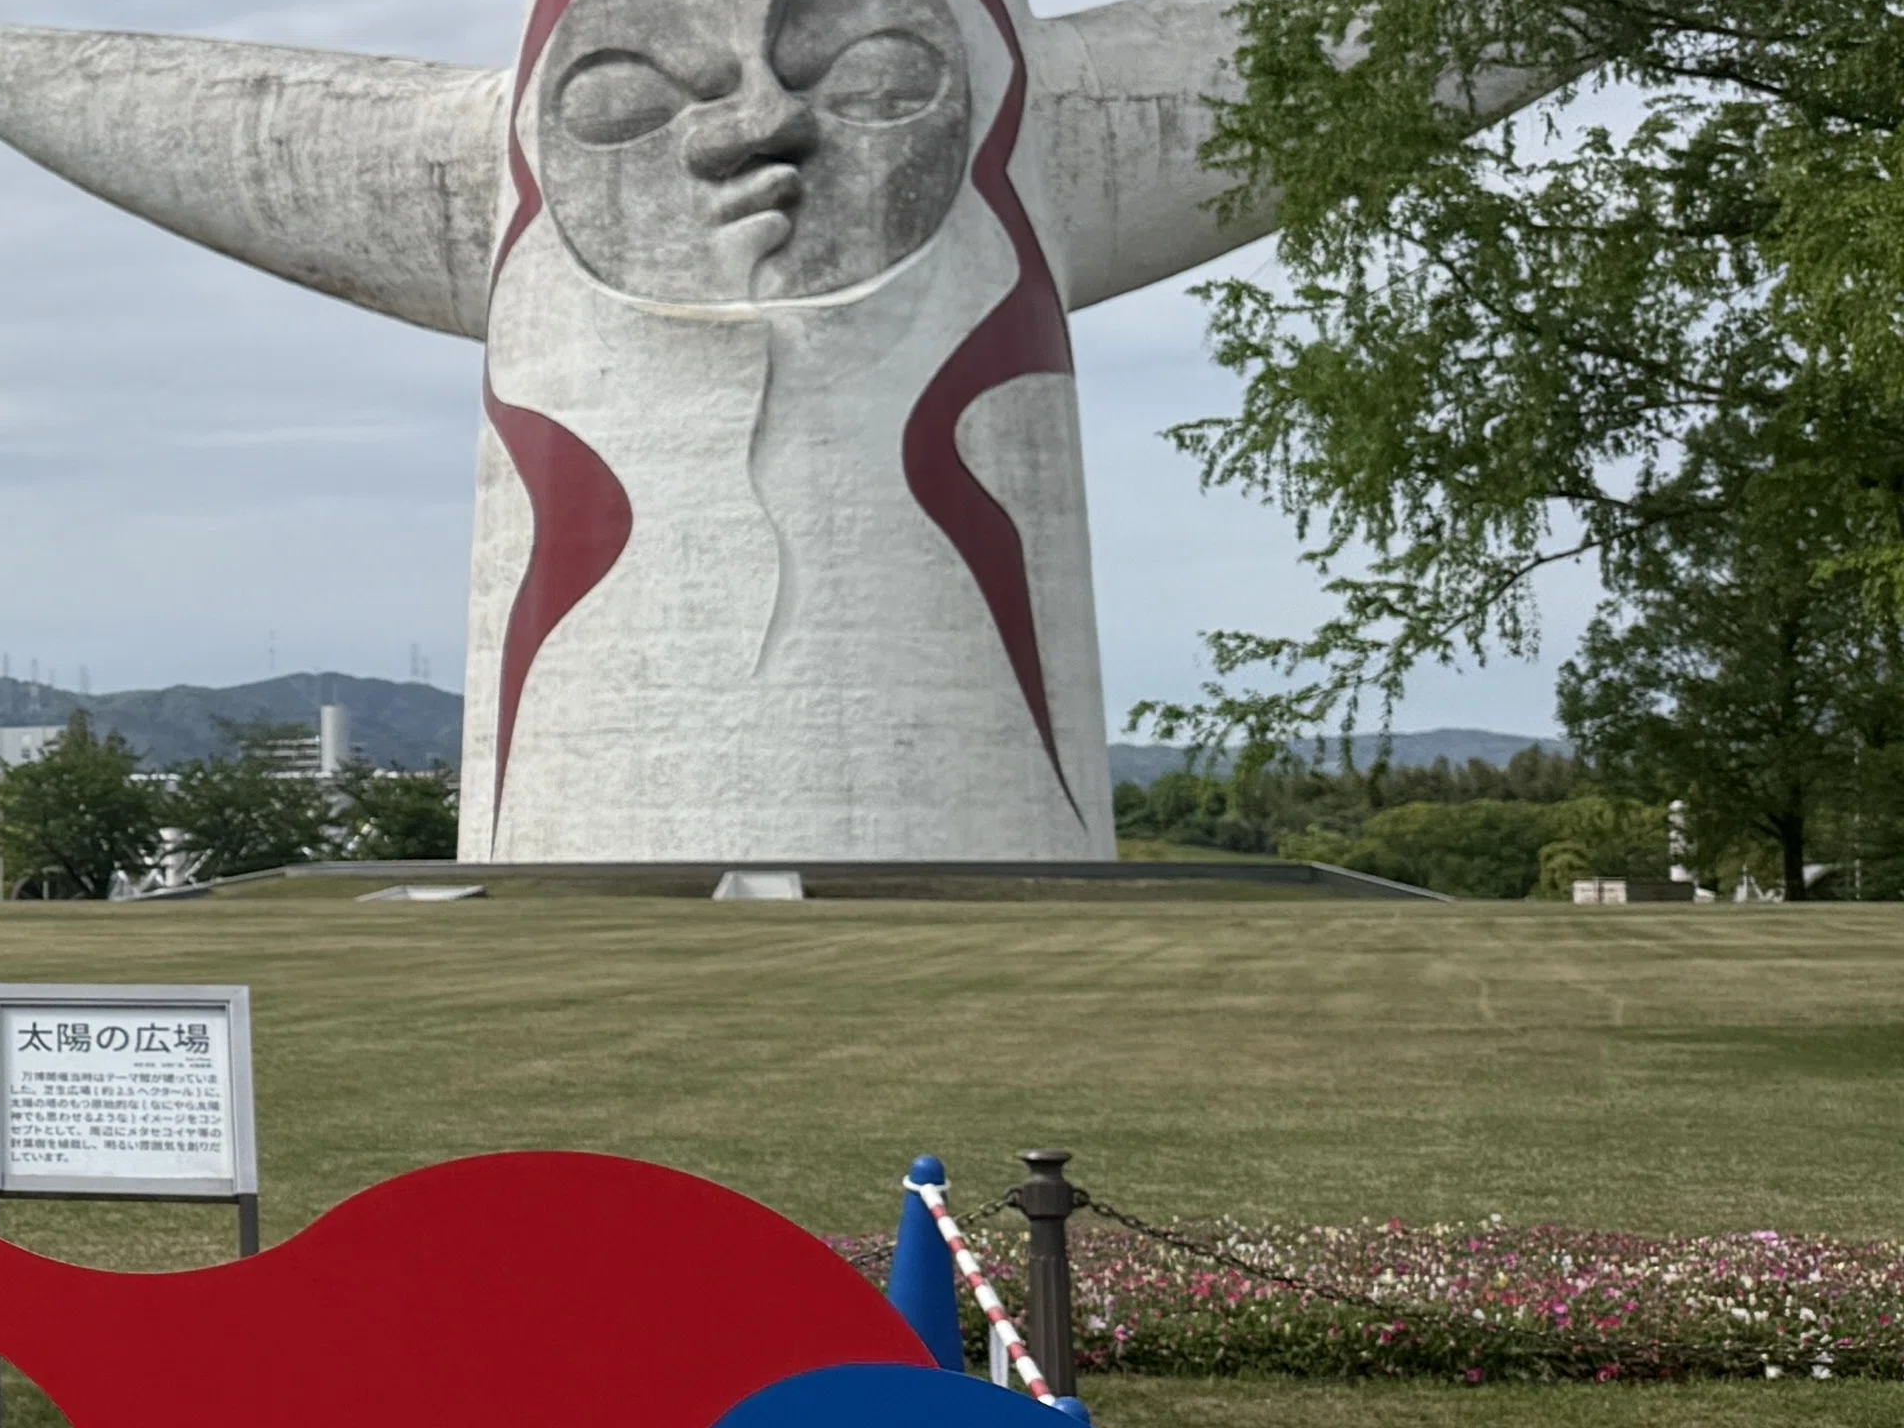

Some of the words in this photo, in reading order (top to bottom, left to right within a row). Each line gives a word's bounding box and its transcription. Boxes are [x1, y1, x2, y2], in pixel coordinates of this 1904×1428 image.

[18, 1022, 210, 1054] 太陽の広場
[11, 1151, 69, 1163] しています。
